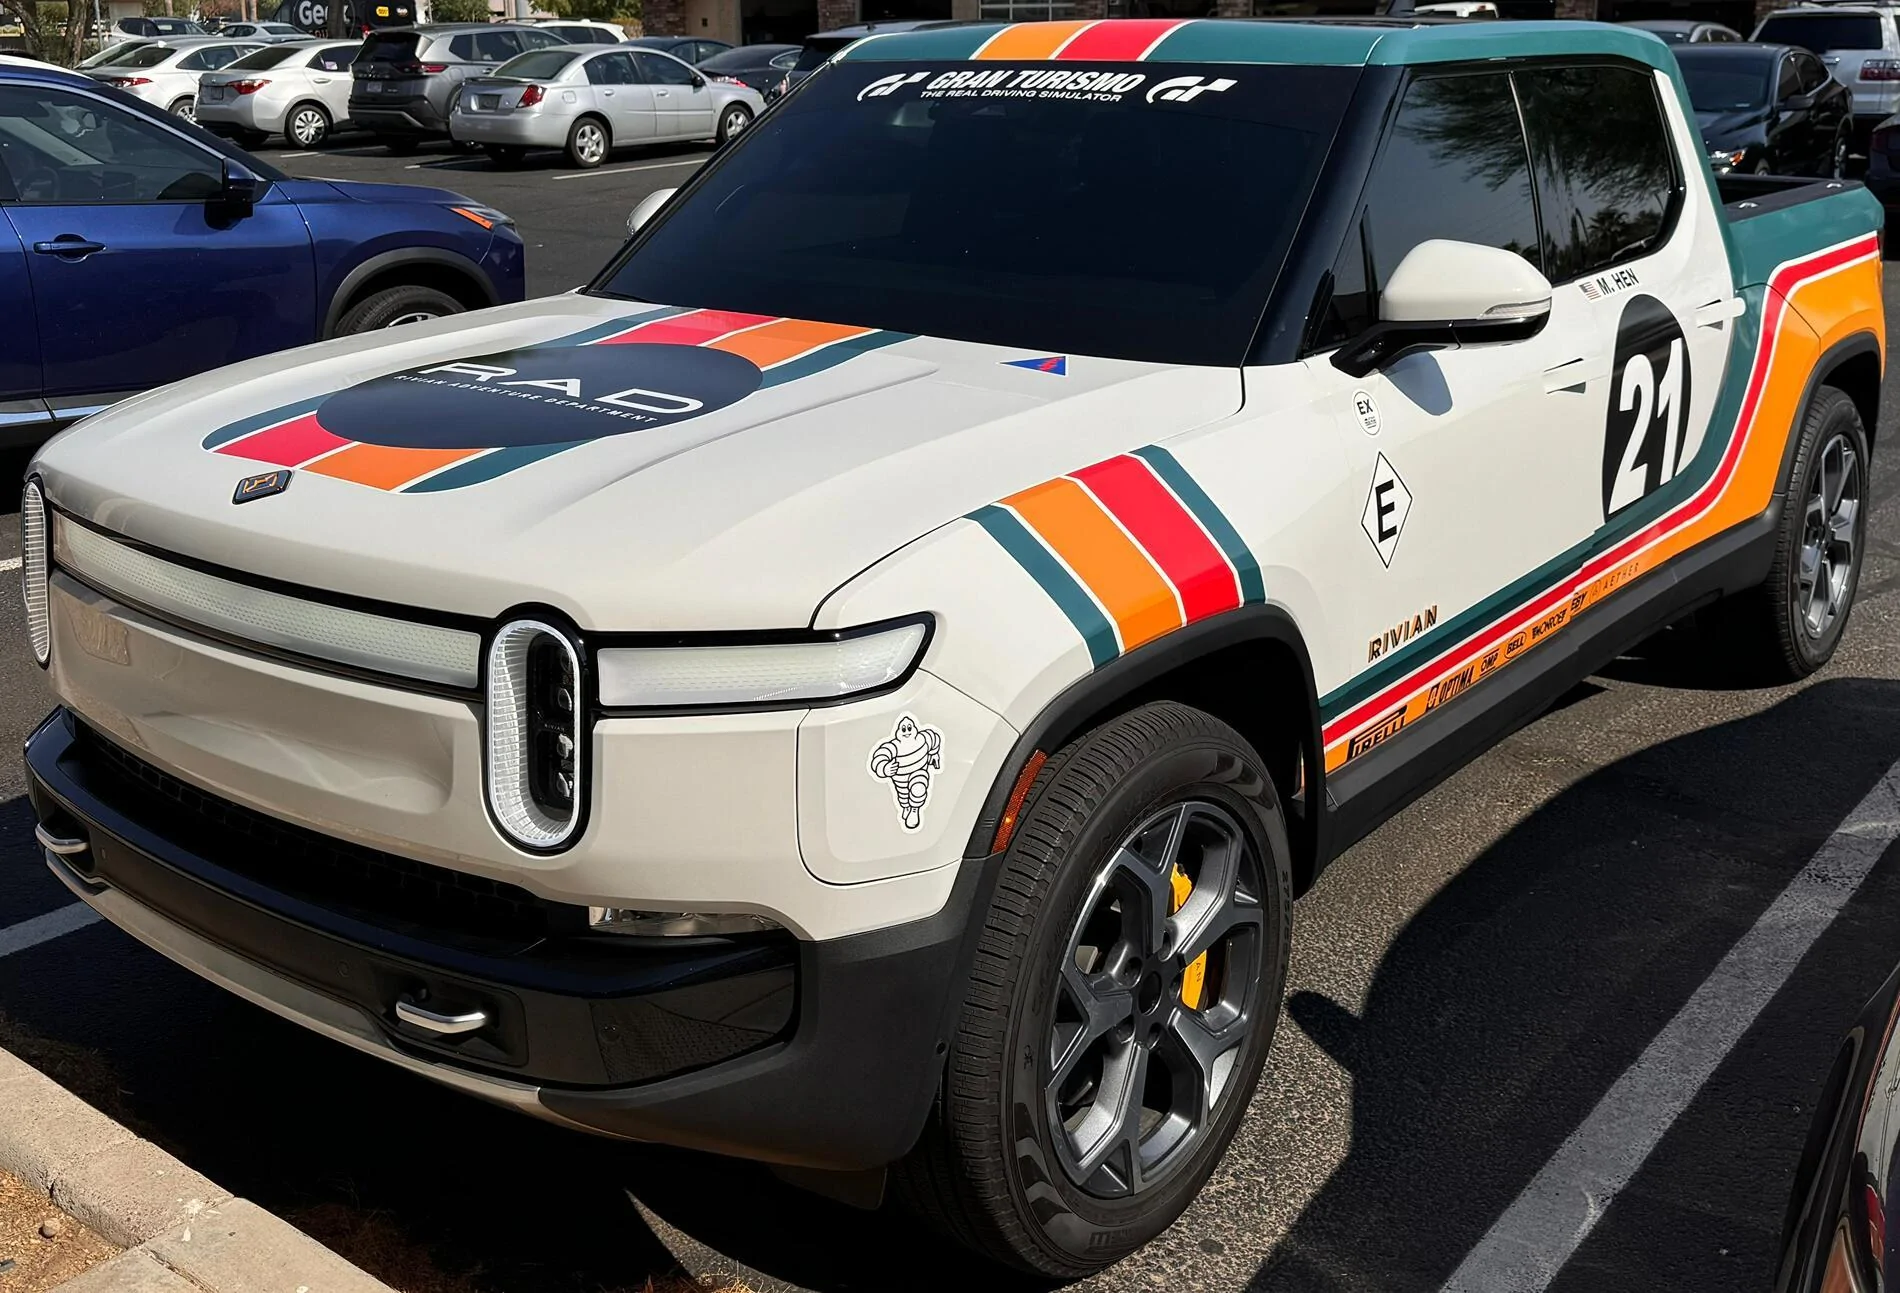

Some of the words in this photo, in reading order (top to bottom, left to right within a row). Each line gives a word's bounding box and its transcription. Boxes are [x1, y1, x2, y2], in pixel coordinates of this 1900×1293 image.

[920, 90, 945, 98] THE
[945, 89, 978, 97] REAL
[977, 89, 1036, 98] DRIVING
[1038, 90, 1122, 102] SIMULATOR
[926, 70, 1014, 90] GRAN
[1006, 70, 1146, 93] TURISMO
[1596, 277, 1616, 296] M.
[1611, 267, 1640, 291] HEN
[393, 375, 448, 385] RIVIAN
[448, 382, 543, 401] ADVENTURE
[544, 398, 658, 423] DEPARTMENT
[417, 362, 704, 414] RAD
[1357, 399, 1373, 415] EX
[1608, 337, 1684, 515] 21
[1375, 479, 1397, 543] E
[1603, 562, 1639, 591] AETHER
[1368, 605, 1437, 663] RIVIAN
[1506, 635, 1525, 655] BELL
[1480, 652, 1499, 671] OMP
[1438, 665, 1475, 703] OPTIMA
[1346, 704, 1408, 761] PIRELLI
